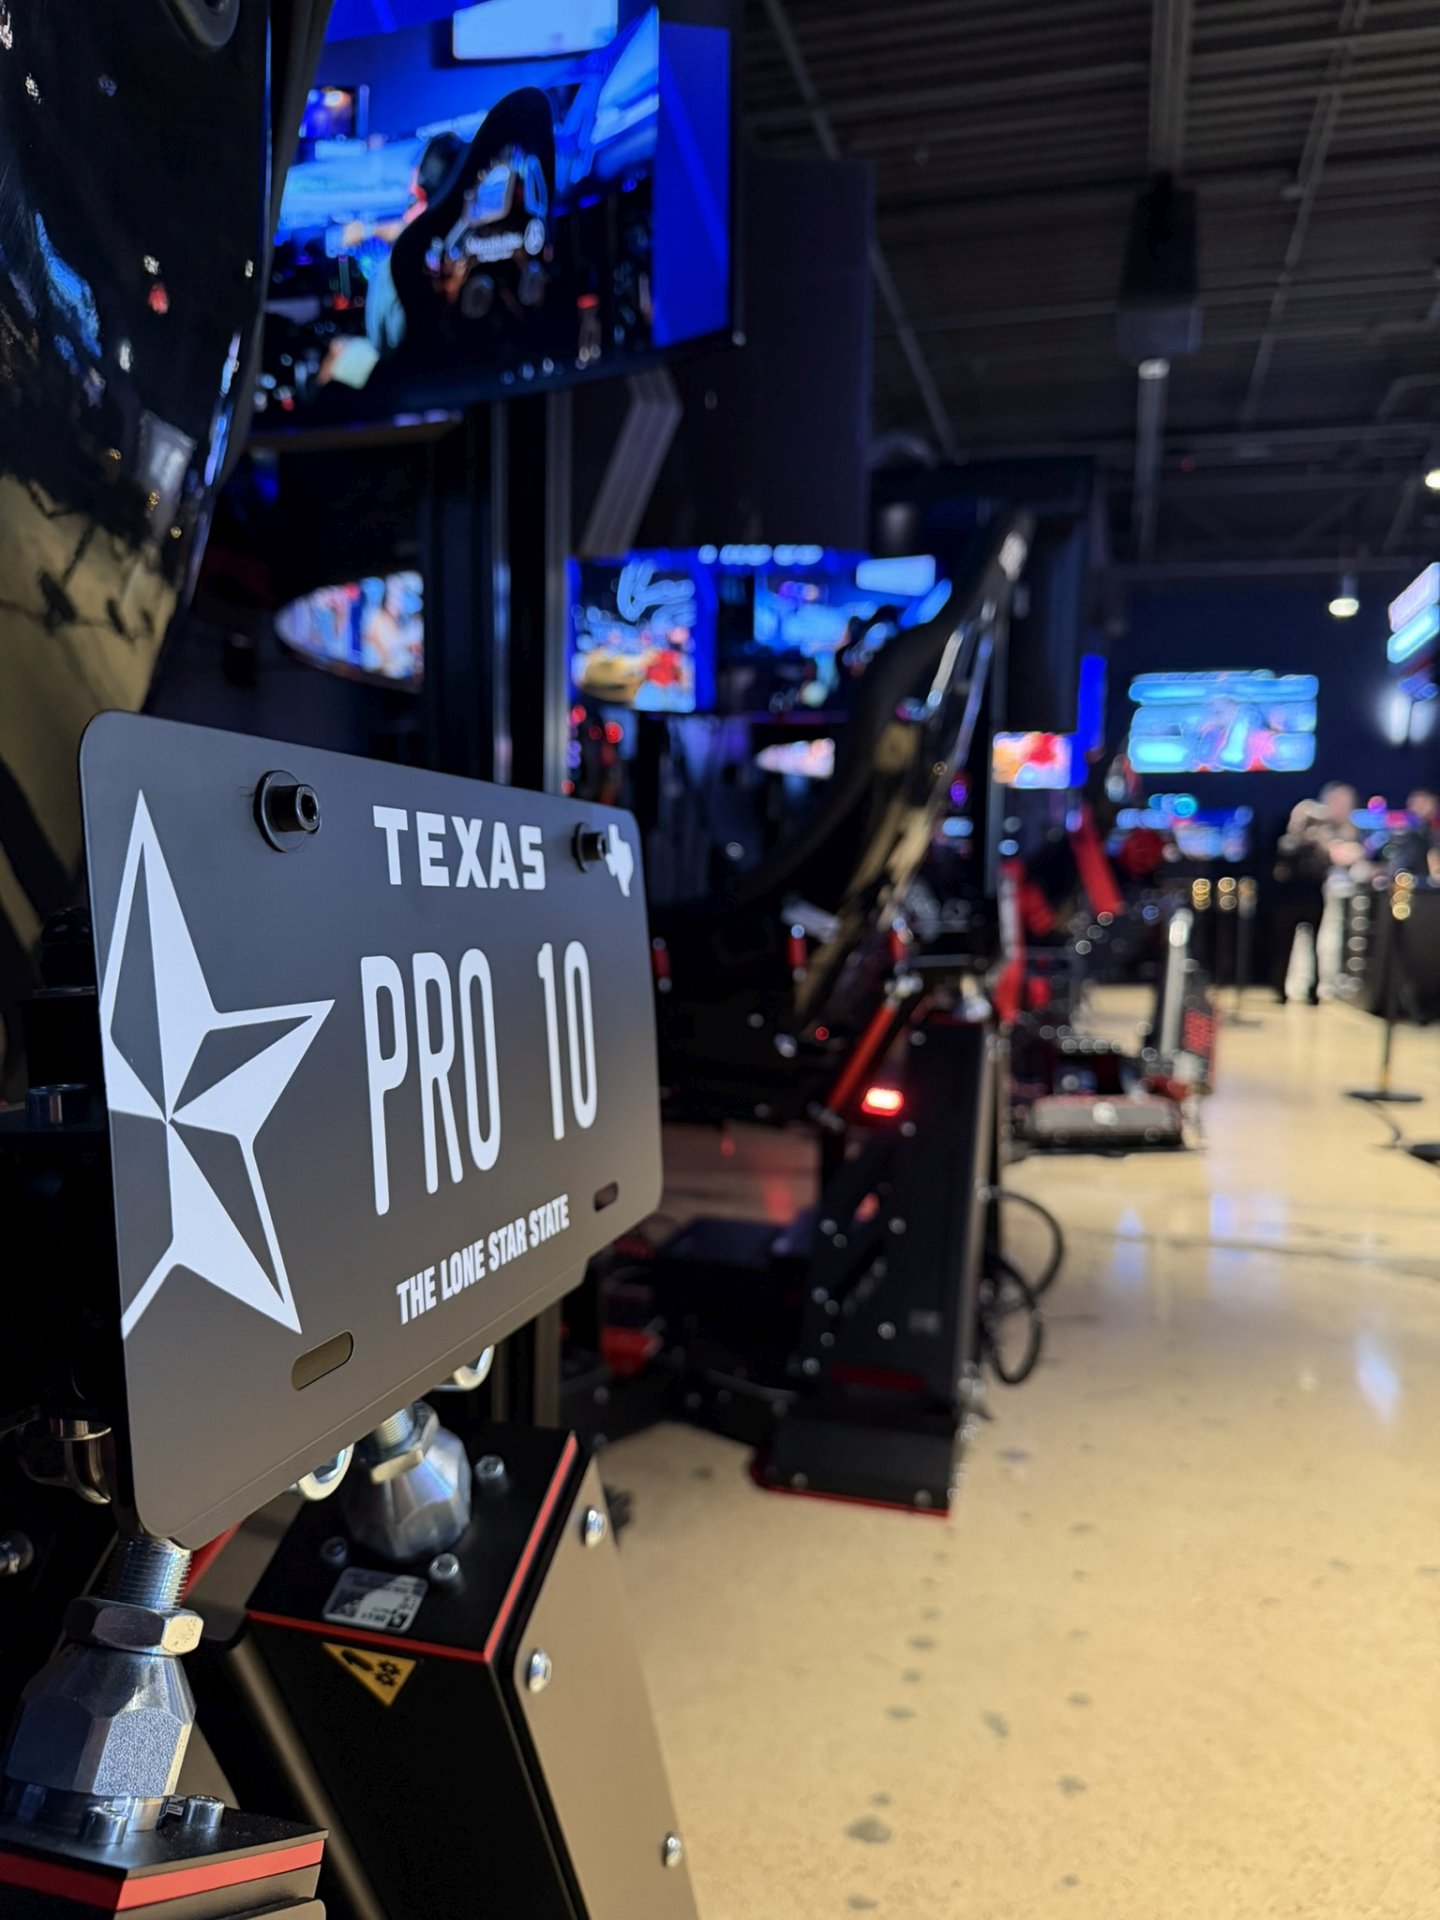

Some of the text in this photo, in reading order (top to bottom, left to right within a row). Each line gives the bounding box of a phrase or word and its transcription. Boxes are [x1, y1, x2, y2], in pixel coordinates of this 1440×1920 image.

[373, 805, 546, 890] TEXAS
[360, 940, 598, 1216] PRO 10
[396, 1193, 570, 1325] THE LONE STAR STATE
